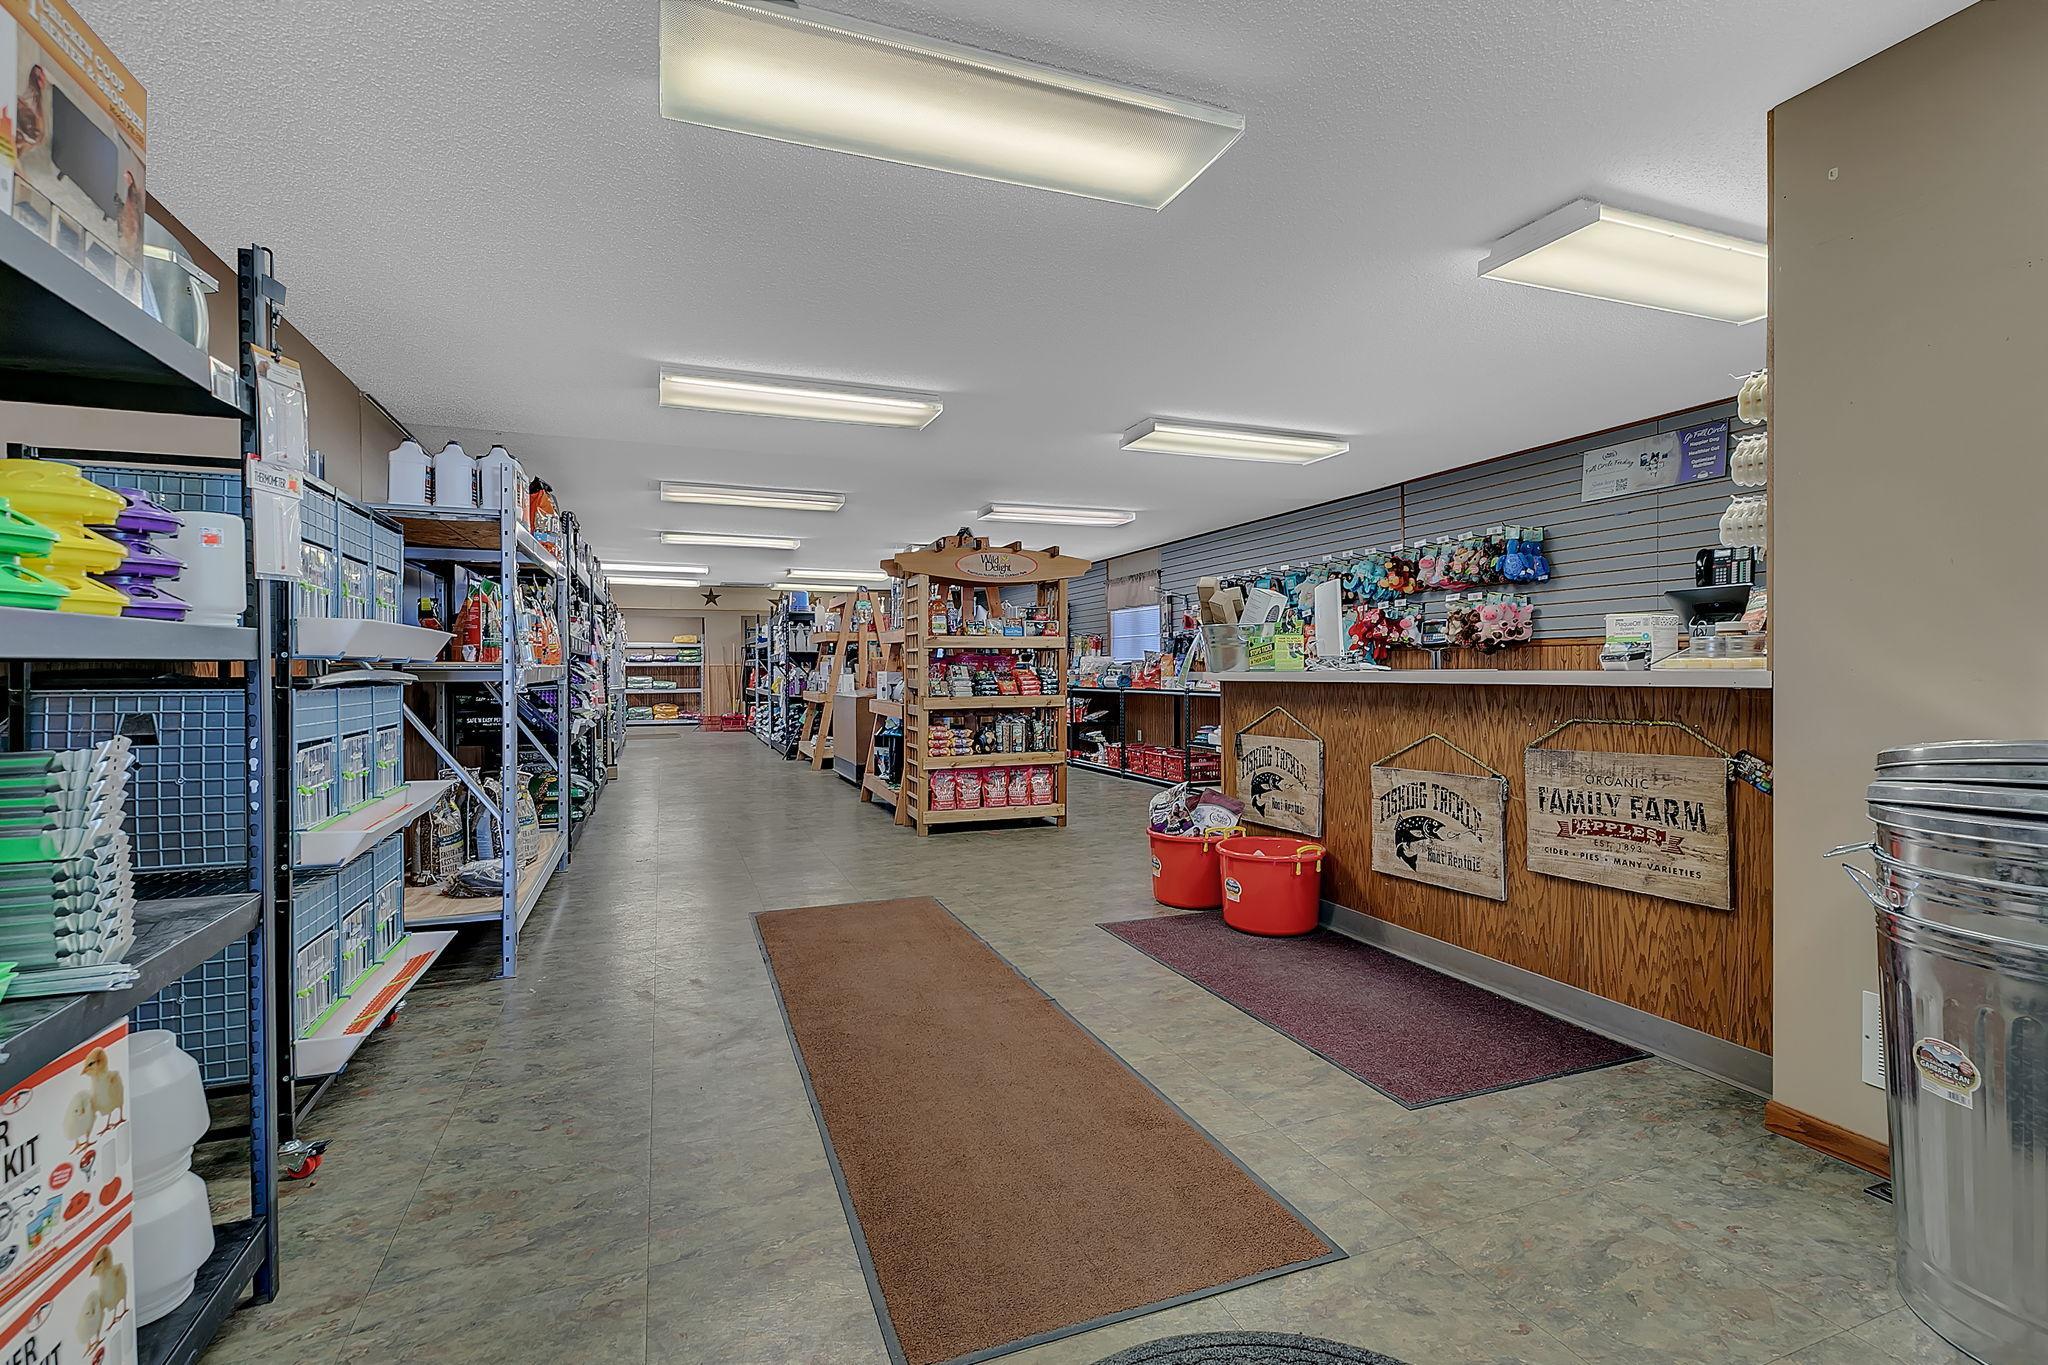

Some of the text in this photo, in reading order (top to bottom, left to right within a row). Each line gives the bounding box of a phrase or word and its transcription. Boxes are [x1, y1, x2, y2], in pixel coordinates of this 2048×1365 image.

[1707, 423, 1727, 435] Circle
[254, 470, 287, 488] THERMOMETER
[980, 554, 1000, 564] Wild
[985, 561, 1012, 574] Delight
[1241, 745, 1307, 791] FISHING TACKLE
[1584, 774, 1650, 790] ORGANIC
[1380, 781, 1482, 843] FISHING TACKLE
[1538, 786, 1708, 833] FAMILY FARM
[1577, 818, 1658, 843] APPLES
[1617, 842, 1642, 853] 1893
[1544, 846, 1702, 880] CIDER PIES MANY VARIETIES
[1920, 1059, 1953, 1078] GARBAGE
[1953, 1073, 1970, 1085] CAN
[4, 1133, 39, 1184] KIT
